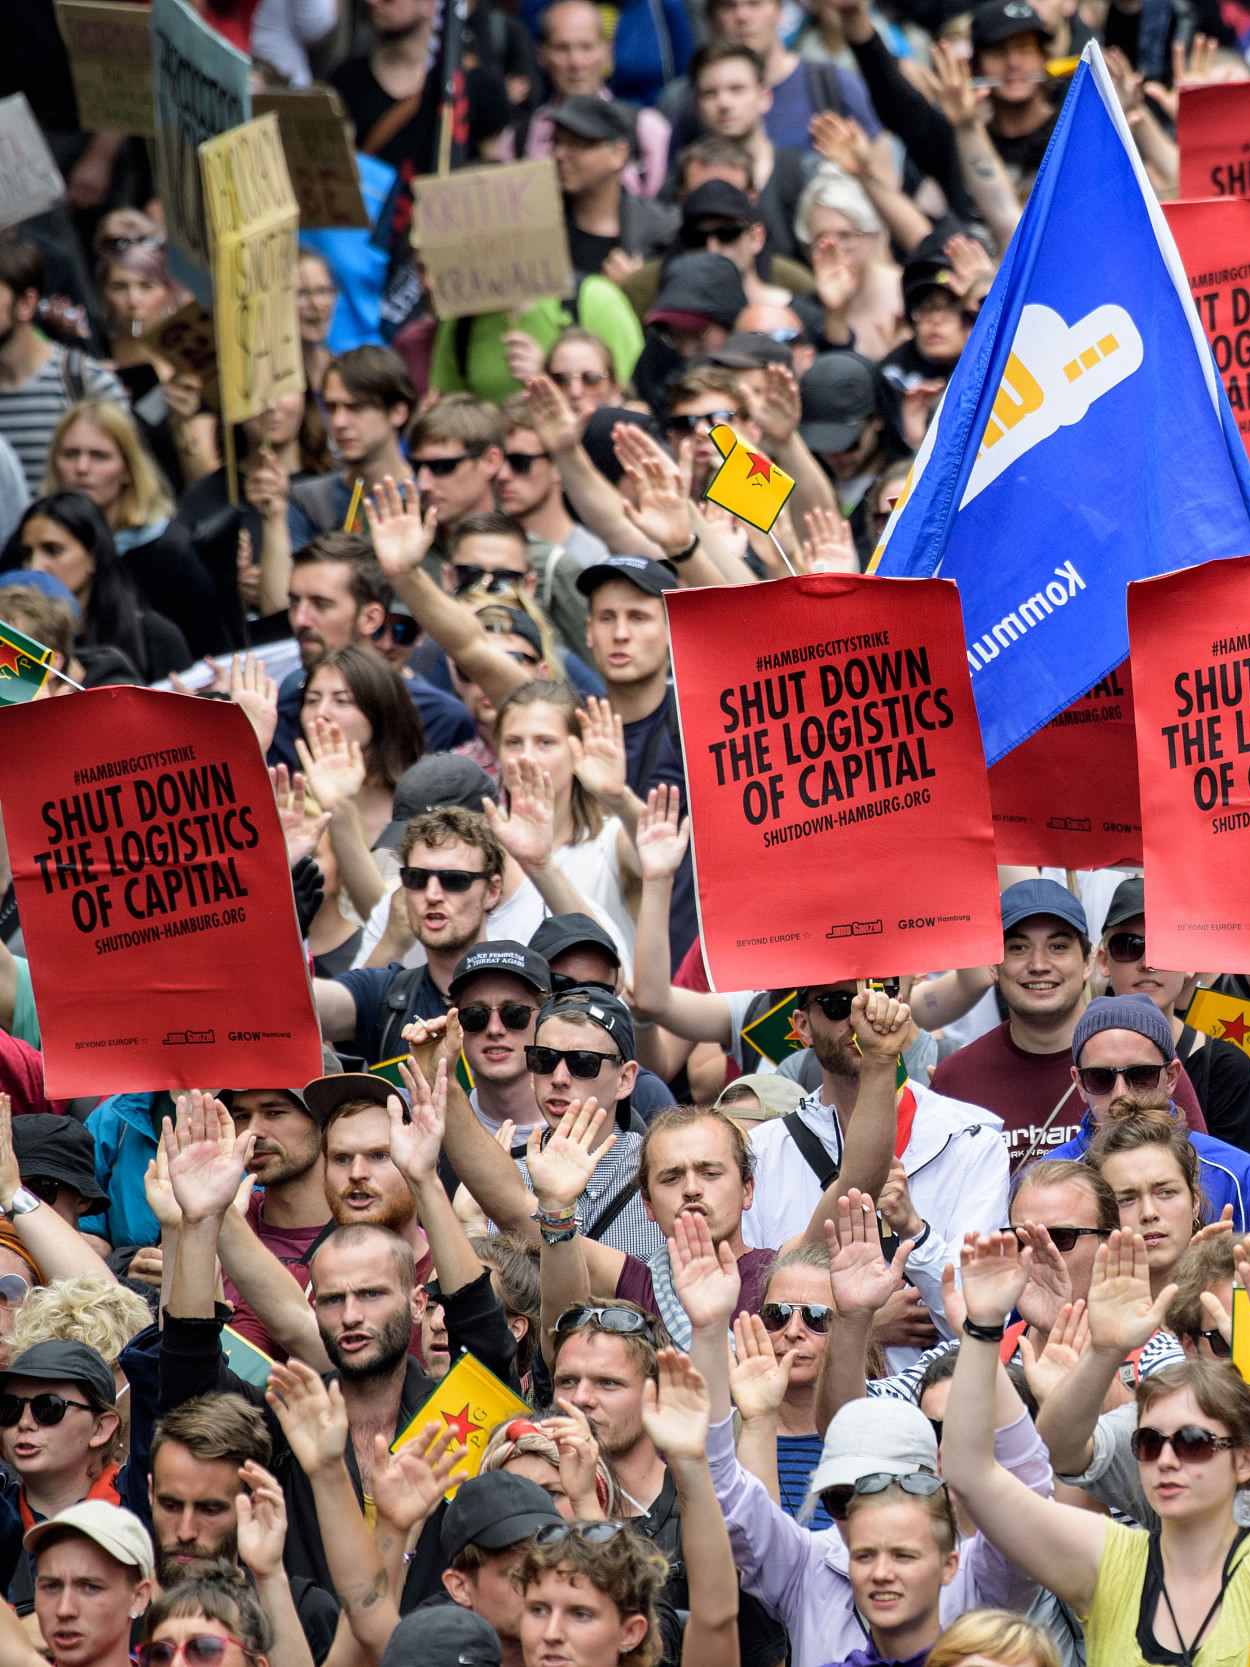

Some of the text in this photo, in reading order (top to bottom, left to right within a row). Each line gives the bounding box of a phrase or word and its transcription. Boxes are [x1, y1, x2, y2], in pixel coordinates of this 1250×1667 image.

[755, 630, 889, 673] #HAMBURGCITYSTRIKE
[719, 646, 932, 733] SHUT DOWN
[1051, 705, 1122, 727] HAMBURG.ORG
[708, 688, 953, 786] THE LOGISTICS
[1161, 715, 1223, 769] THE
[74, 746, 196, 785] #HAMBURGCITYSTRIKE
[742, 737, 935, 825] OF CAPITAL
[1193, 762, 1235, 811] OF
[42, 763, 237, 845] SHUT DOWN
[763, 788, 931, 848] SHUTDOWN-HAMBURG.ORG
[34, 807, 259, 895] THE LOGISTICS
[72, 857, 248, 933] OF CAPITAL
[95, 907, 246, 955] SHUTDOWN-HAMBURG.ORG
[736, 937, 768, 947] BEYOND
[769, 932, 801, 943] EUROPE
[898, 917, 935, 929] GROW
[937, 914, 971, 923] Hamburg
[75, 1040, 107, 1049] BEYOND
[108, 1038, 139, 1048] EUROPE
[228, 1031, 261, 1041] GROW
